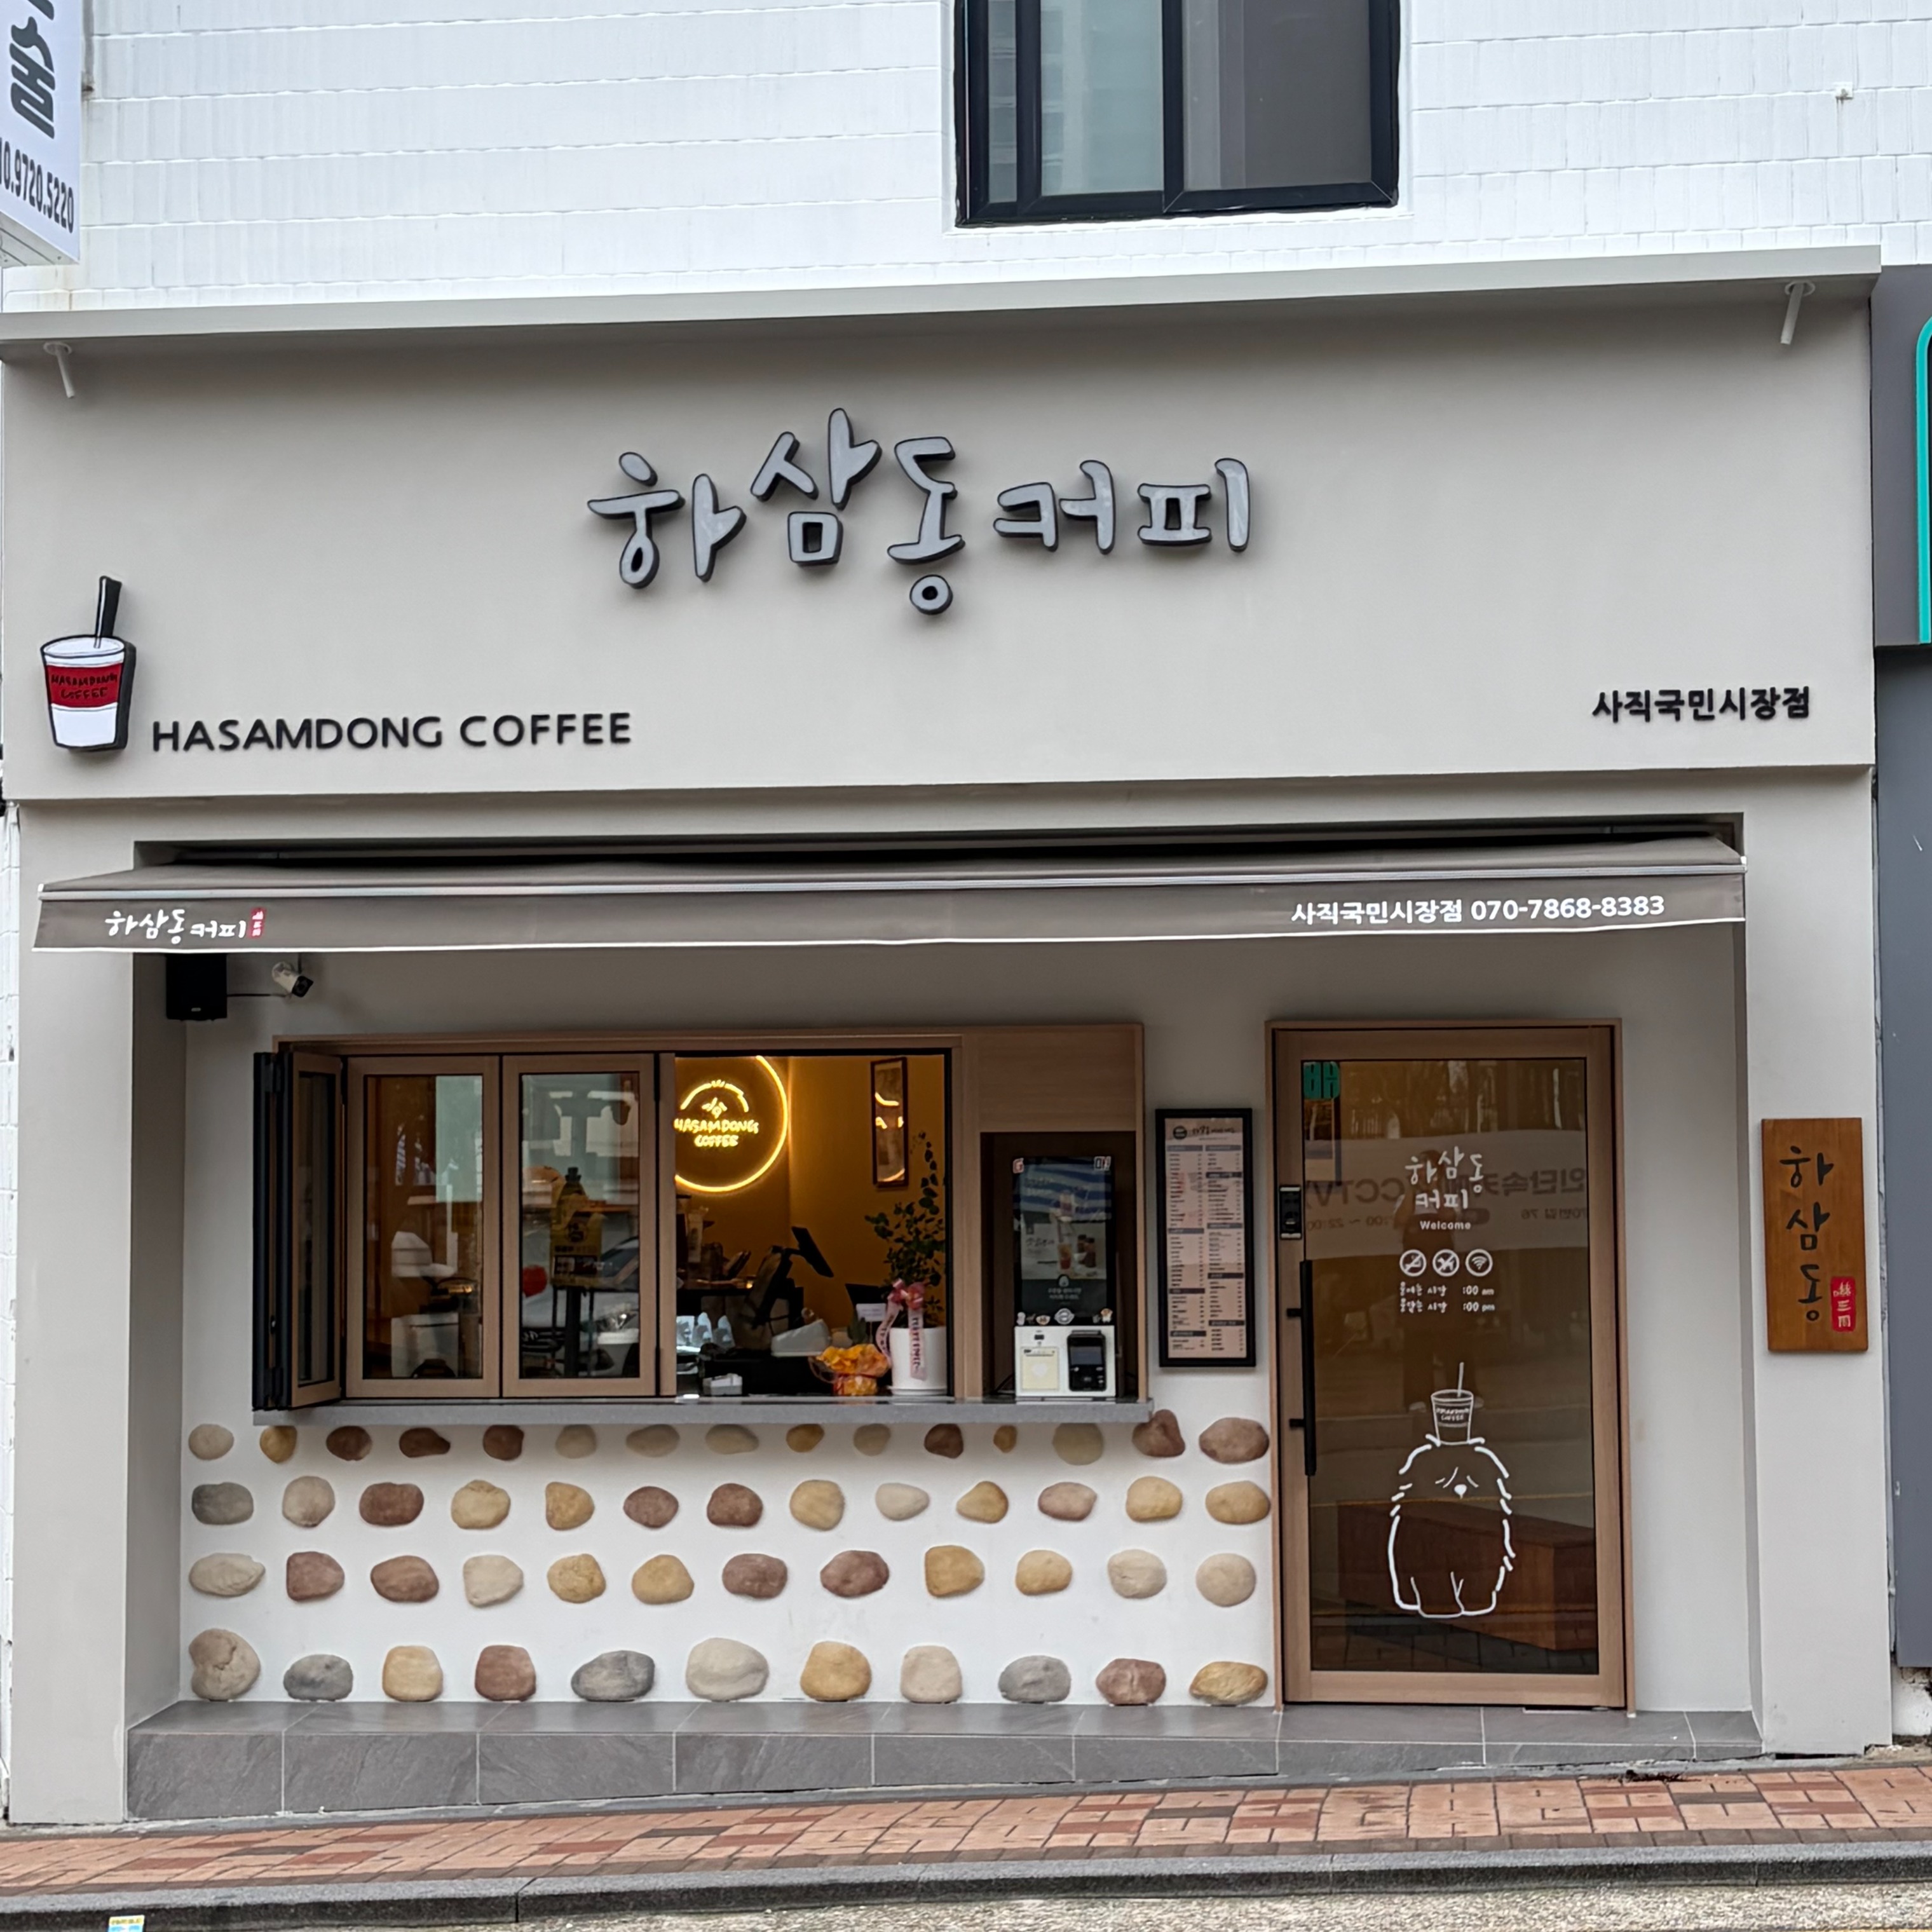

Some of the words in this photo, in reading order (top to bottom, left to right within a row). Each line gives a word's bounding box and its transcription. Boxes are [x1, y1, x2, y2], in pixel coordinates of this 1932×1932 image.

[1592, 686, 1809, 723] 사직국민시장점
[153, 715, 442, 752] HASAMDONG
[460, 711, 632, 749] COFFEE
[1291, 899, 1462, 925] 사직국민시장점
[1471, 895, 1665, 921] 070-7868-8383
[1405, 1146, 1483, 1194] 하삼동
[1415, 1188, 1469, 1209] 커피
[1420, 1220, 1471, 1230] Welcome
[1779, 1145, 1835, 1321] 하삼동
